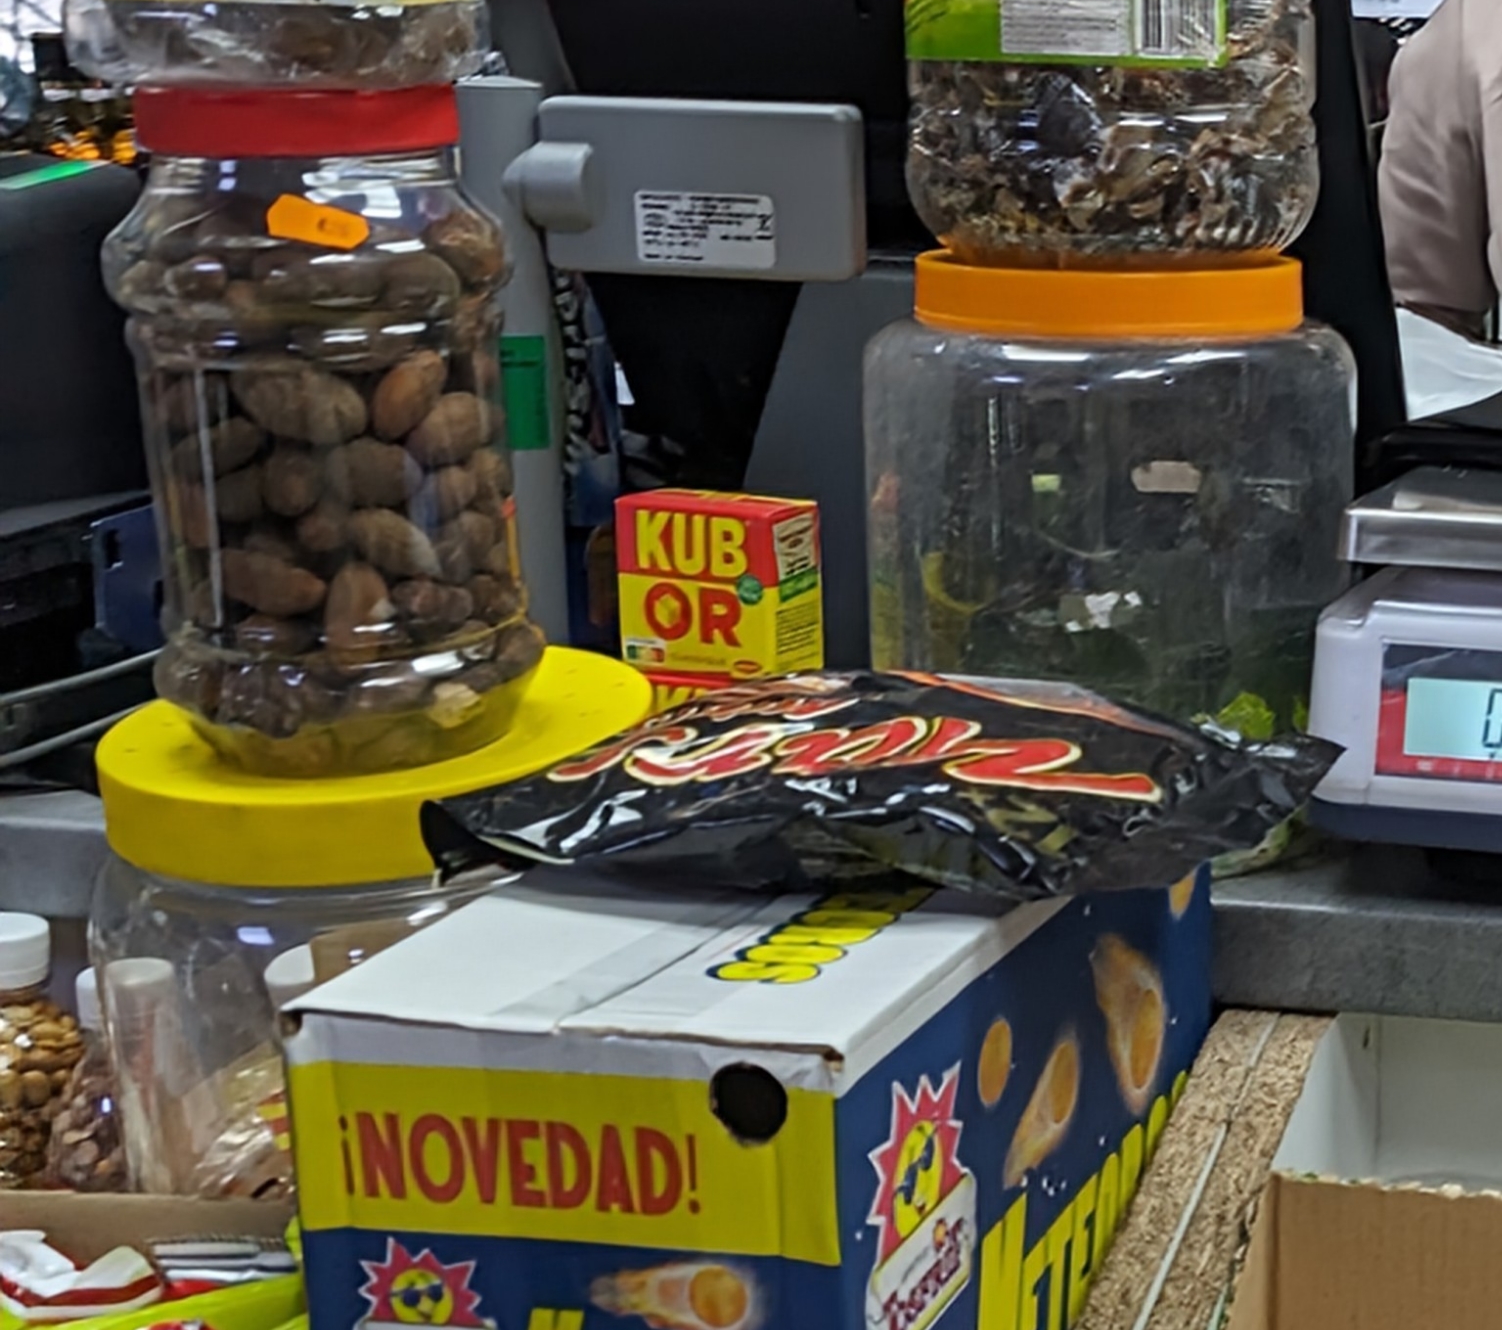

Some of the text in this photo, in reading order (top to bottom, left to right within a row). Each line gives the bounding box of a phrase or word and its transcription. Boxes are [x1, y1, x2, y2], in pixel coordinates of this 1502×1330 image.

[635, 509, 749, 578] KUB
[643, 581, 743, 648] OR
[338, 1109, 702, 1217] ¡NOVEDAD!
